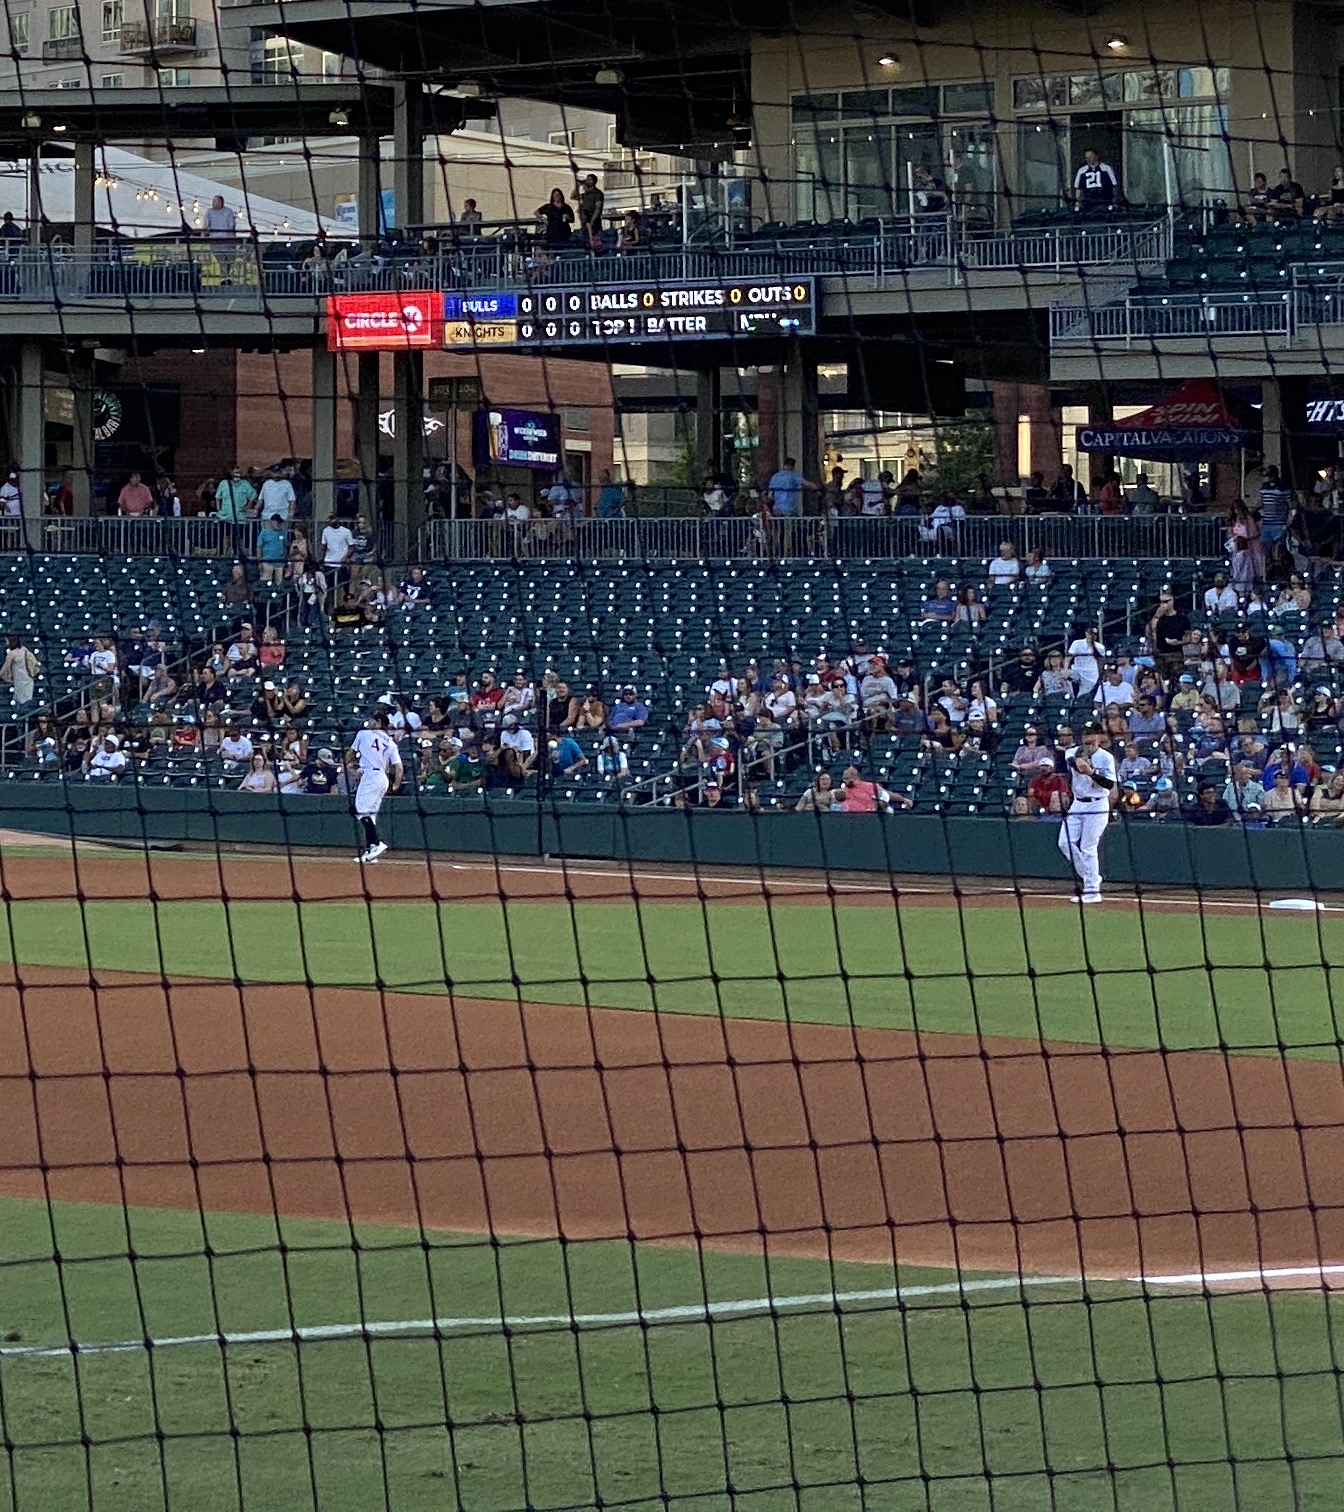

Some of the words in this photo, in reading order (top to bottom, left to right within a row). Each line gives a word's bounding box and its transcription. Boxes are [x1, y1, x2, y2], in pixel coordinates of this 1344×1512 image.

[1085, 171, 1102, 188] 21
[521, 297, 532, 312] 0
[545, 296, 557, 312] 0
[569, 295, 581, 311] 0
[591, 293, 639, 310] BALLS
[643, 292, 654, 307] 0
[660, 289, 724, 307] STRIKES
[730, 288, 742, 304] 0
[748, 285, 792, 303] OUTS
[794, 285, 806, 301] 0
[462, 299, 498, 314] BULLS
[344, 310, 398, 329] CIRCLE
[646, 315, 707, 333] BATTER
[455, 326, 505, 339] KNIGHTS
